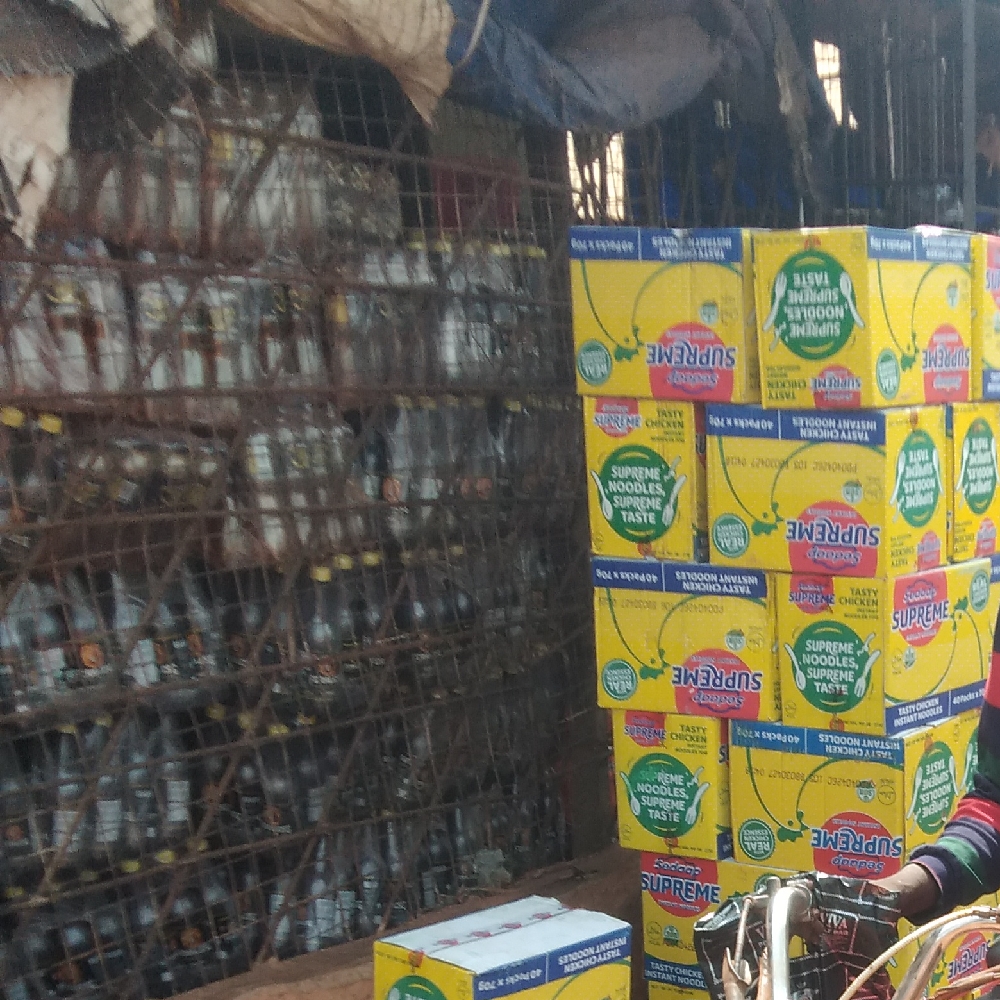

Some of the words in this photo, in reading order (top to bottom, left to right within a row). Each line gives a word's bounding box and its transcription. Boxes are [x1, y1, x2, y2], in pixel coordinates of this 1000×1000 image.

[794, 272, 828, 287] TASTE
[787, 286, 839, 303] SUPREME
[790, 319, 840, 337] SUPREME
[646, 339, 737, 368] SUPREME
[922, 343, 971, 371] SUPREME
[594, 413, 641, 430] SUPREME
[656, 409, 683, 418] TASTY
[835, 419, 877, 431] INSTANT
[800, 428, 839, 440] CHICKEN
[842, 429, 869, 442] TASTY
[612, 465, 661, 483] SUPREME
[608, 480, 665, 496] NOODLES,
[613, 495, 662, 513] SUPREME
[621, 511, 656, 524] TASTE
[785, 517, 881, 547] SUPREME
[676, 571, 718, 582] NOODLES
[719, 573, 758, 586] INSTANT
[682, 581, 722, 592] CHICKEN
[724, 583, 751, 594] TASTY
[850, 587, 879, 596] TASTY
[788, 591, 835, 609] SUPREME
[839, 598, 879, 607] CHICKEN
[891, 600, 950, 631] SUPREME
[805, 639, 854, 655] SUPREME
[802, 653, 859, 670] NOODLES,
[671, 663, 763, 692] SUPREME
[807, 668, 855, 684] SUPREME
[607, 681, 633, 691] REAL
[814, 682, 849, 695] TASTE
[898, 705, 914, 716] TASTY
[915, 698, 939, 712] CHICKEN
[893, 713, 917, 727] INSTANT
[917, 706, 943, 721] NOODLES
[624, 725, 667, 740] SUPREME
[680, 725, 707, 733] TASTY
[671, 733, 707, 743] CHICKEN
[819, 733, 860, 745] NOODLES
[861, 738, 900, 749] INSTANT
[825, 744, 864, 756] CHICKEN
[866, 748, 894, 760] TASTY
[926, 759, 945, 770] TASTE
[640, 769, 684, 786] SUPREME
[922, 770, 949, 789] SUPREME
[637, 783, 689, 800] NOODLES,
[641, 797, 686, 811] SUPREME
[922, 797, 949, 818] SUPREME
[649, 809, 680, 822] TASTE
[743, 841, 771, 851] REAL
[811, 827, 903, 858] SUPREME
[653, 858, 702, 880] Sedaap
[832, 855, 885, 872] Sedaap
[642, 872, 721, 903] SUPREME
[595, 937, 626, 955] INSTANT
[645, 970, 677, 981] INSTANT
[651, 962, 674, 972] TASTY
[674, 967, 704, 979] CHICKE
